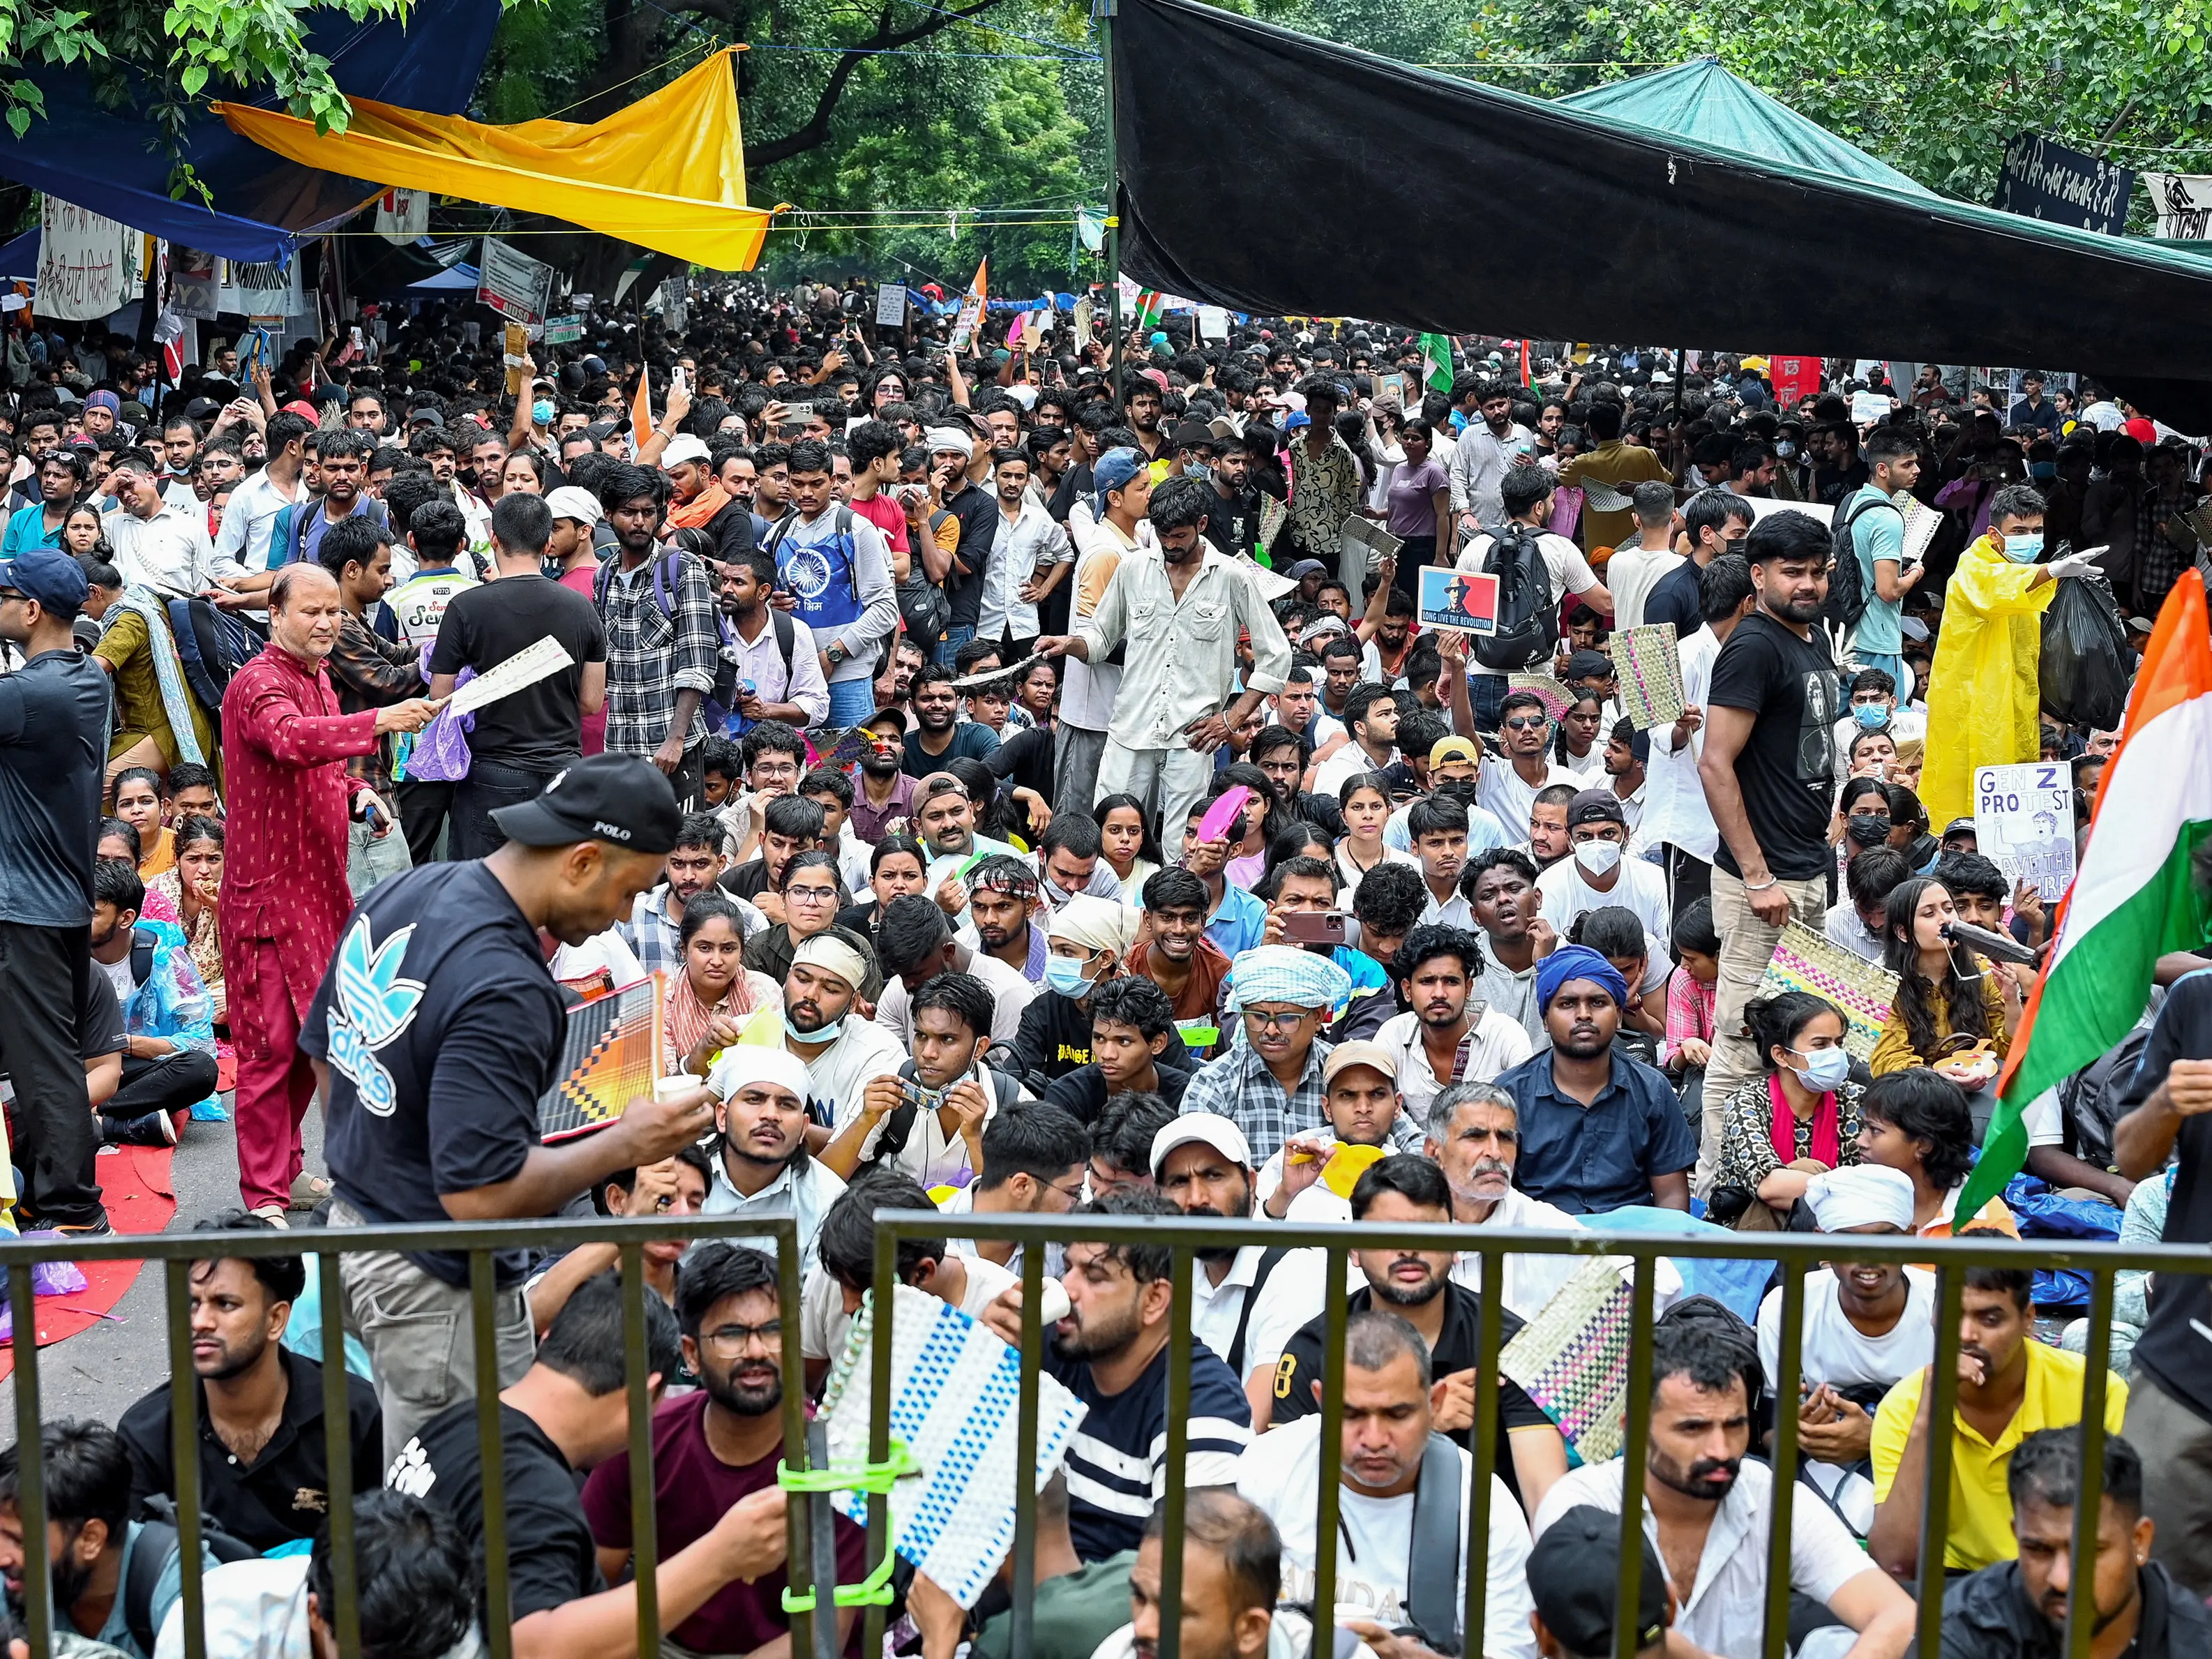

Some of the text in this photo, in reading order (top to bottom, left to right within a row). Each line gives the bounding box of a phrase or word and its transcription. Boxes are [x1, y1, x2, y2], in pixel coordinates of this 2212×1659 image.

[502, 302, 530, 322] AIDSO
[804, 598, 823, 611] भिम
[1423, 611, 1492, 629] LONG LIVE THE REVOLUTION
[1980, 767, 2058, 793] GEN Z
[1982, 790, 2069, 813] PROTEST
[592, 820, 632, 841] POLO
[2043, 850, 2072, 872] THE
[1274, 1353, 1297, 1399] 8
